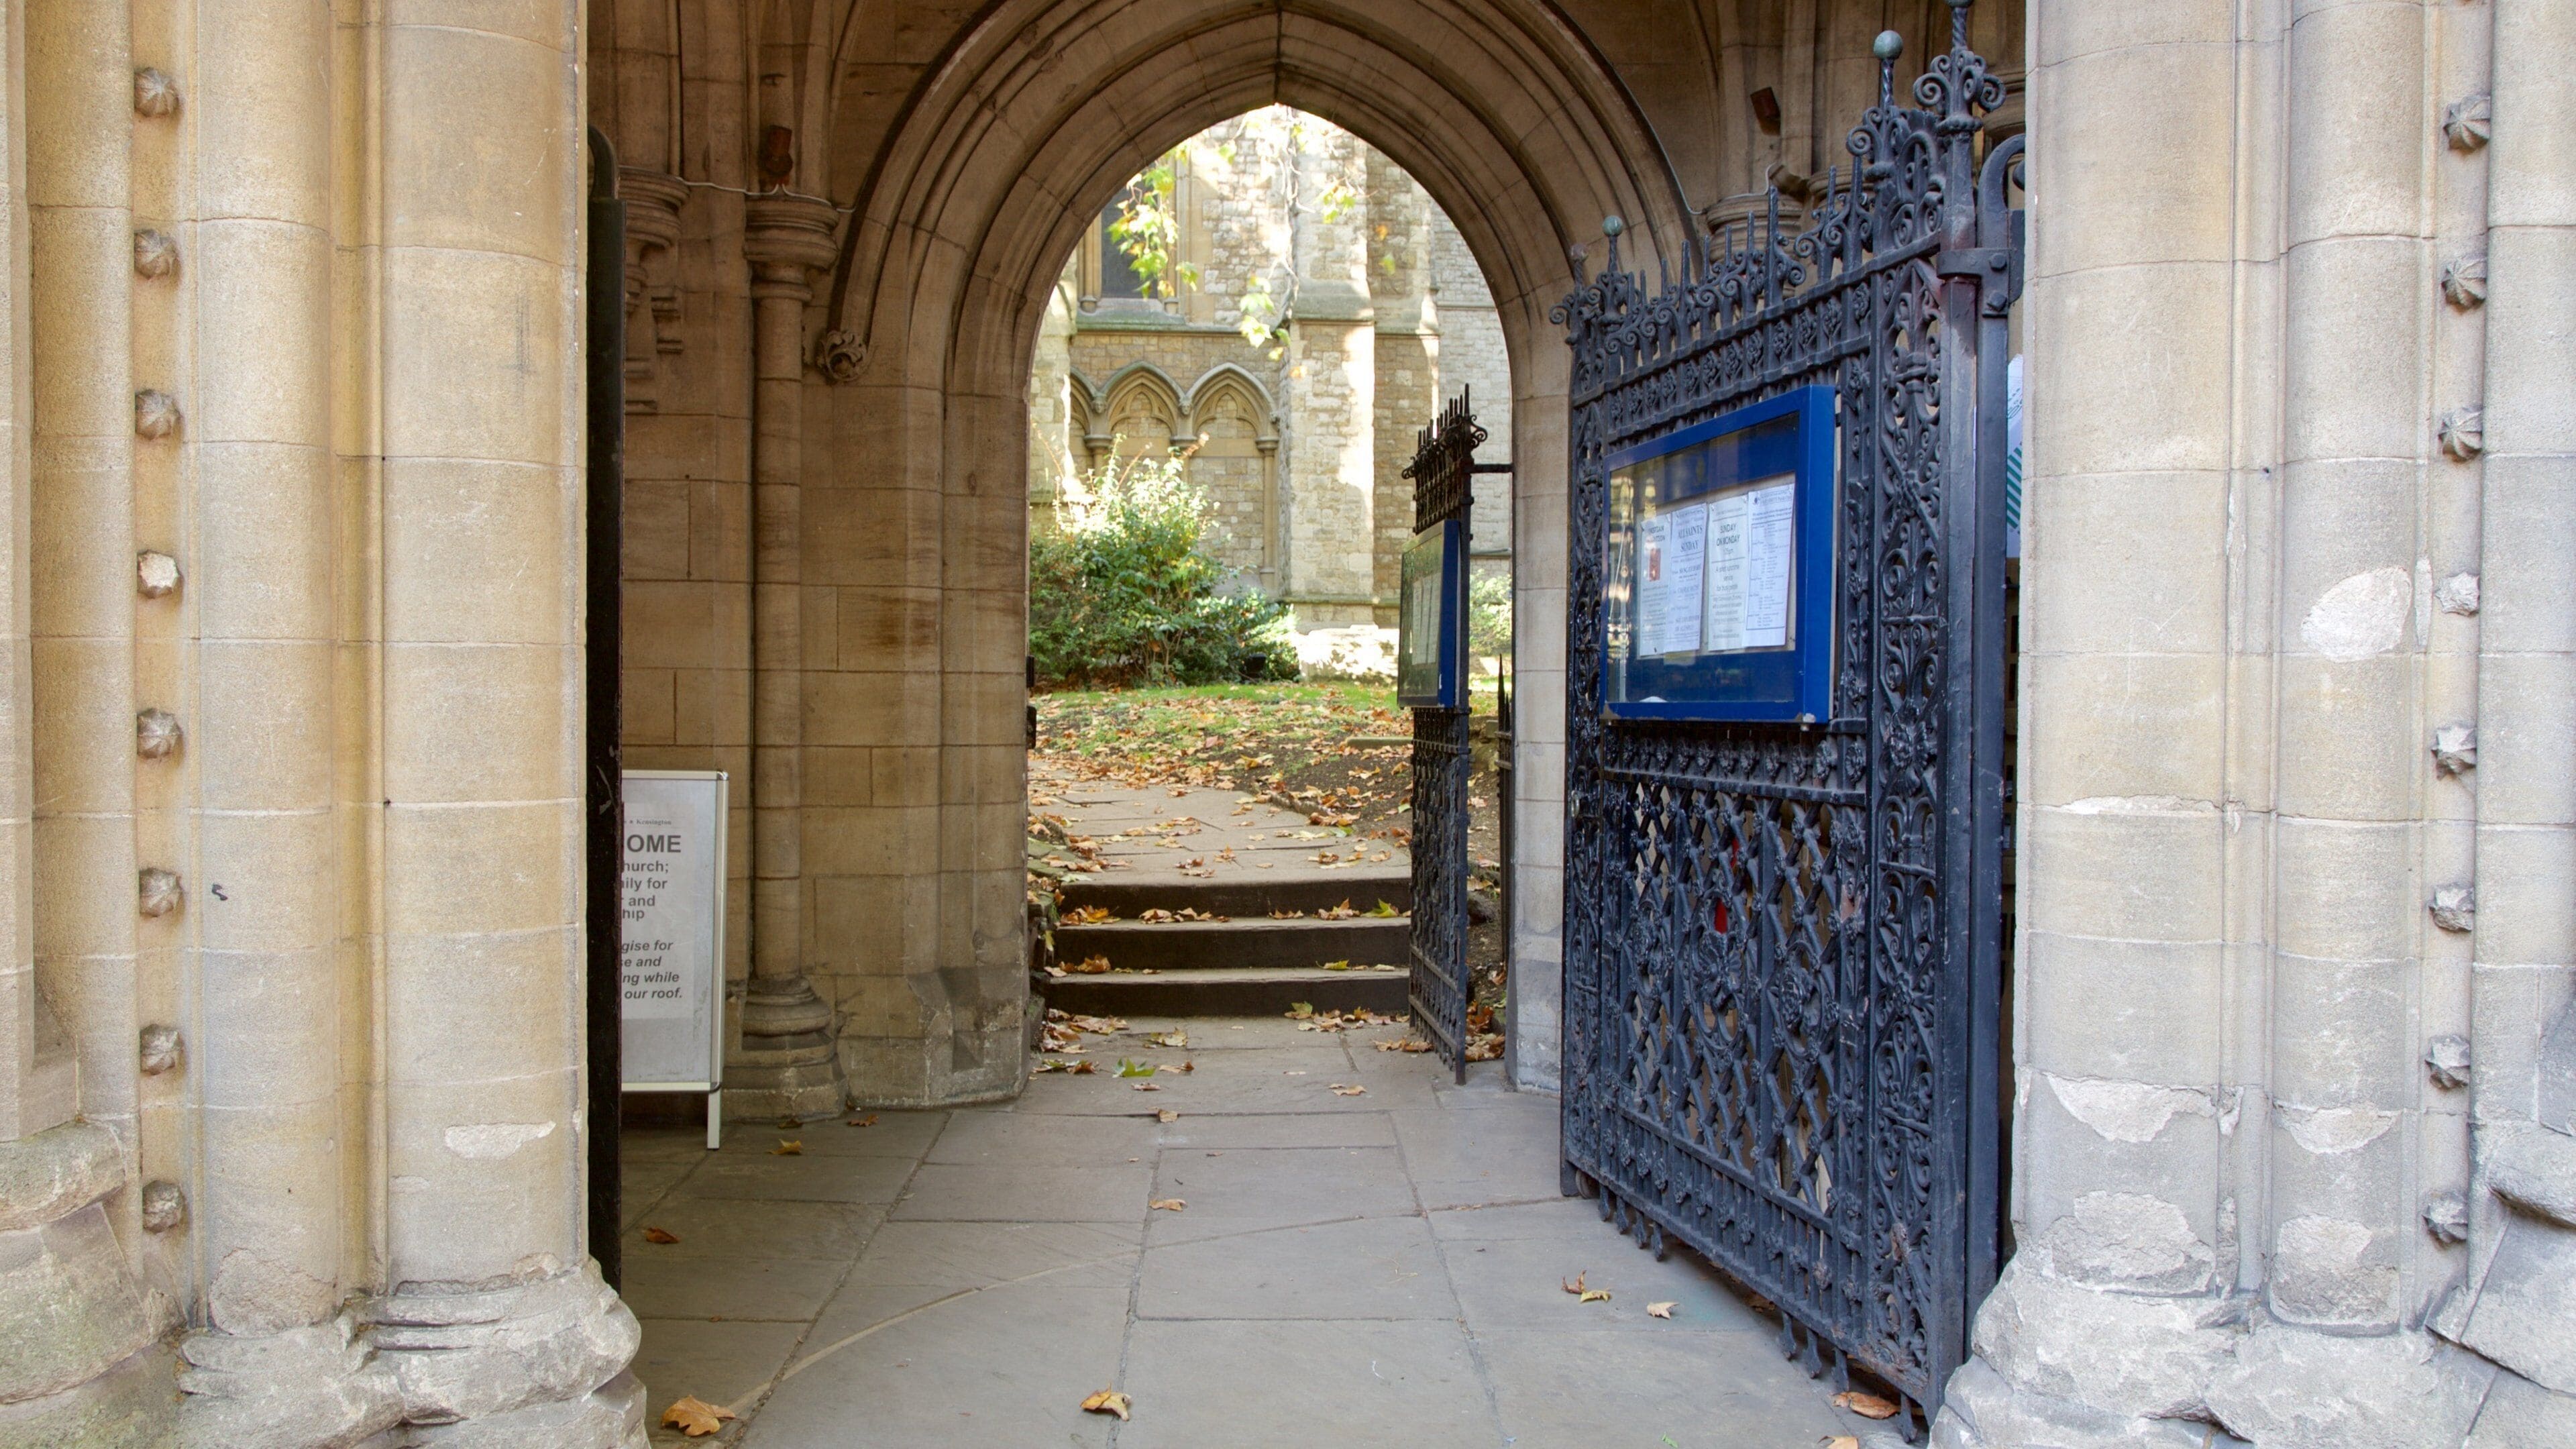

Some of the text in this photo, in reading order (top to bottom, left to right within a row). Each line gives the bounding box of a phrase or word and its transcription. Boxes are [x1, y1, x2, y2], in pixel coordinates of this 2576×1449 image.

[627, 834, 682, 853] OME
[623, 861, 669, 873] hurch;
[622, 877, 668, 892] ily for
[629, 895, 655, 906] and
[623, 908, 645, 922] hip
[622, 940, 674, 953] gise for
[636, 956, 662, 967] and
[622, 972, 680, 985] ng while
[625, 987, 683, 999] our roof.
